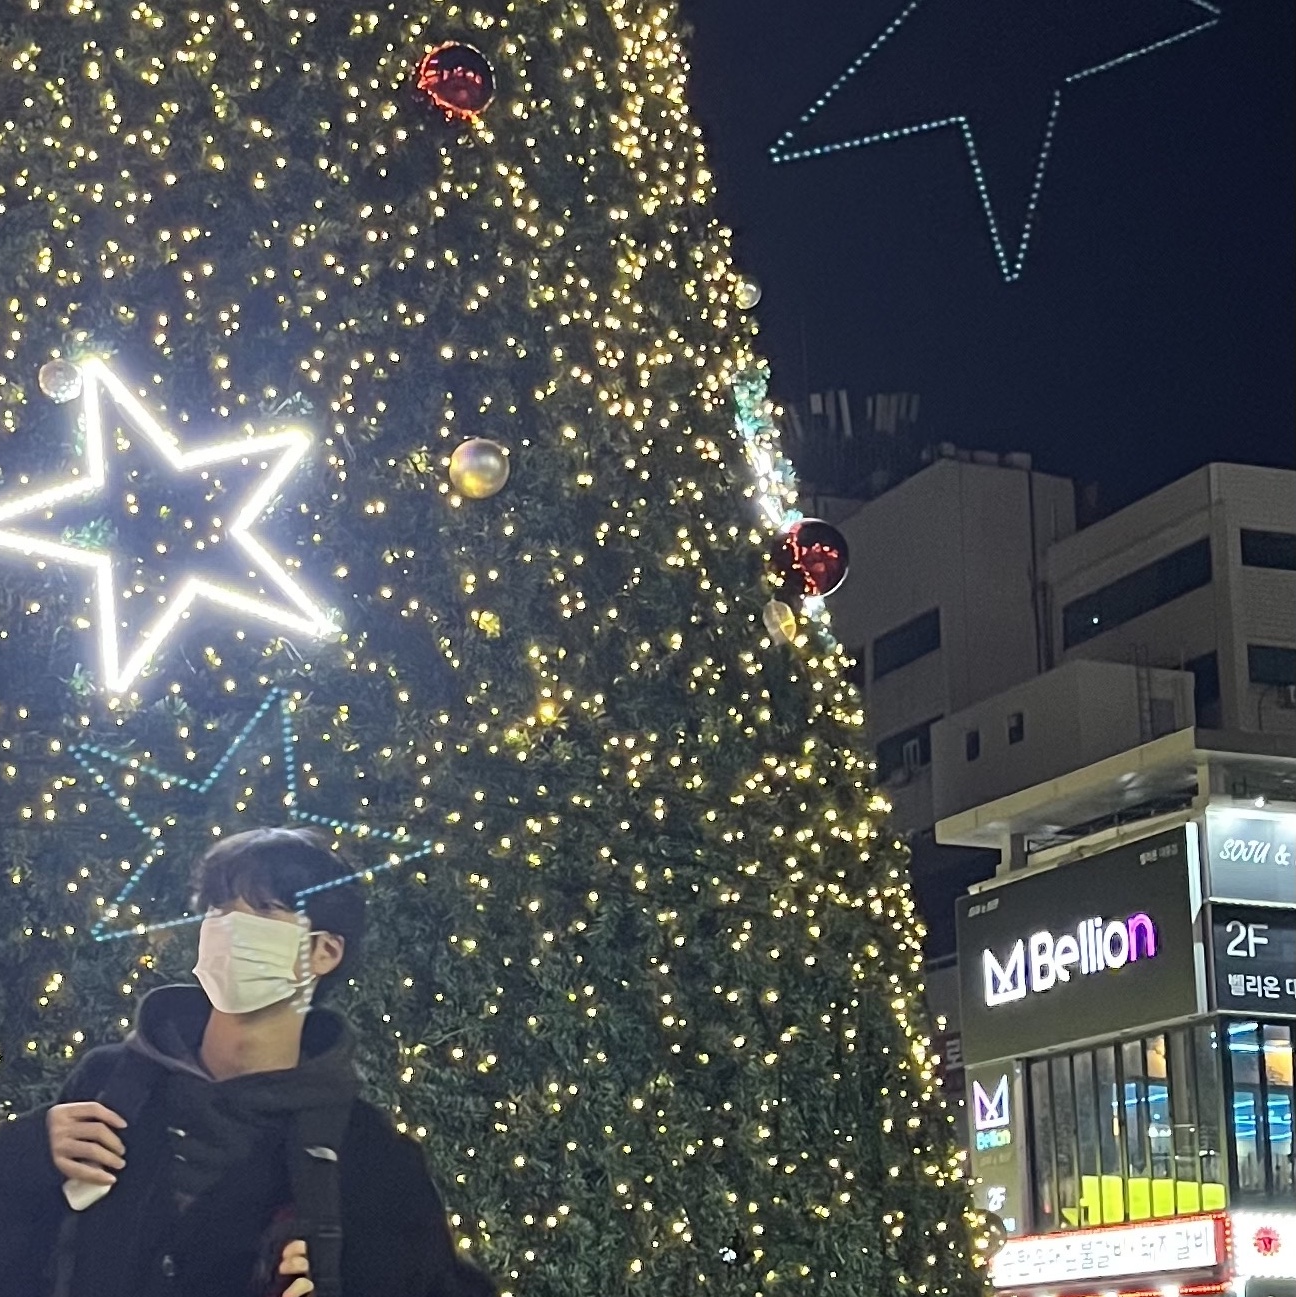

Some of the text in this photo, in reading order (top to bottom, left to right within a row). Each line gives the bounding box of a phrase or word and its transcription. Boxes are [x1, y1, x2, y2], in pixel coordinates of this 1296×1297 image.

[1219, 839, 1271, 864] SOJU
[1030, 912, 1157, 992] Bellion
[1225, 920, 1269, 957] 2F
[1227, 973, 1281, 998] 벨리온
